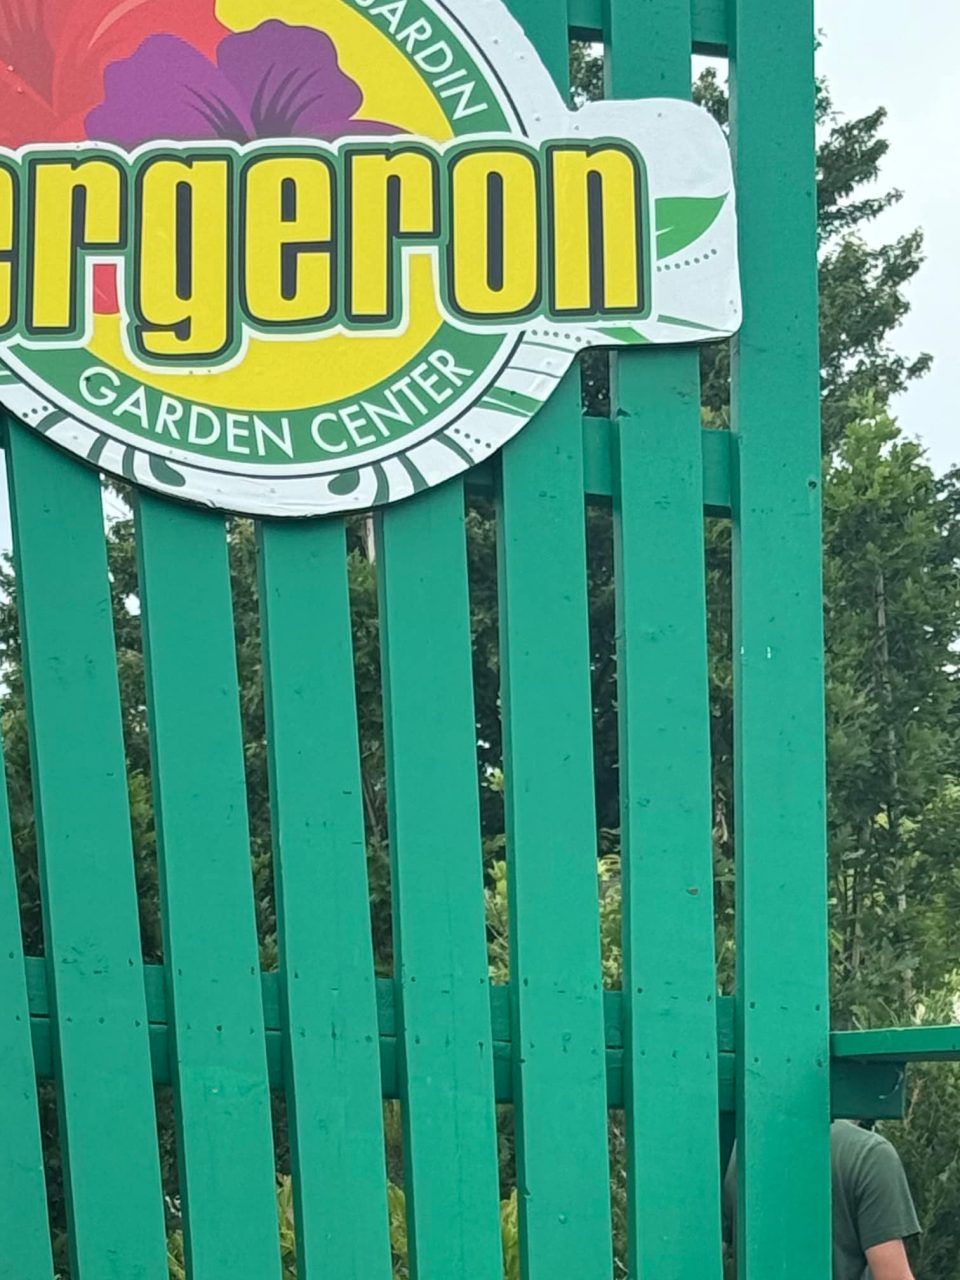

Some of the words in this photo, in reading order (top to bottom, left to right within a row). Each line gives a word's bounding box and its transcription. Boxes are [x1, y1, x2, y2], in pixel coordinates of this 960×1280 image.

[354, 0, 489, 121] ARDIN
[78, 365, 295, 459] GARDEN
[310, 348, 474, 454] CENTER
